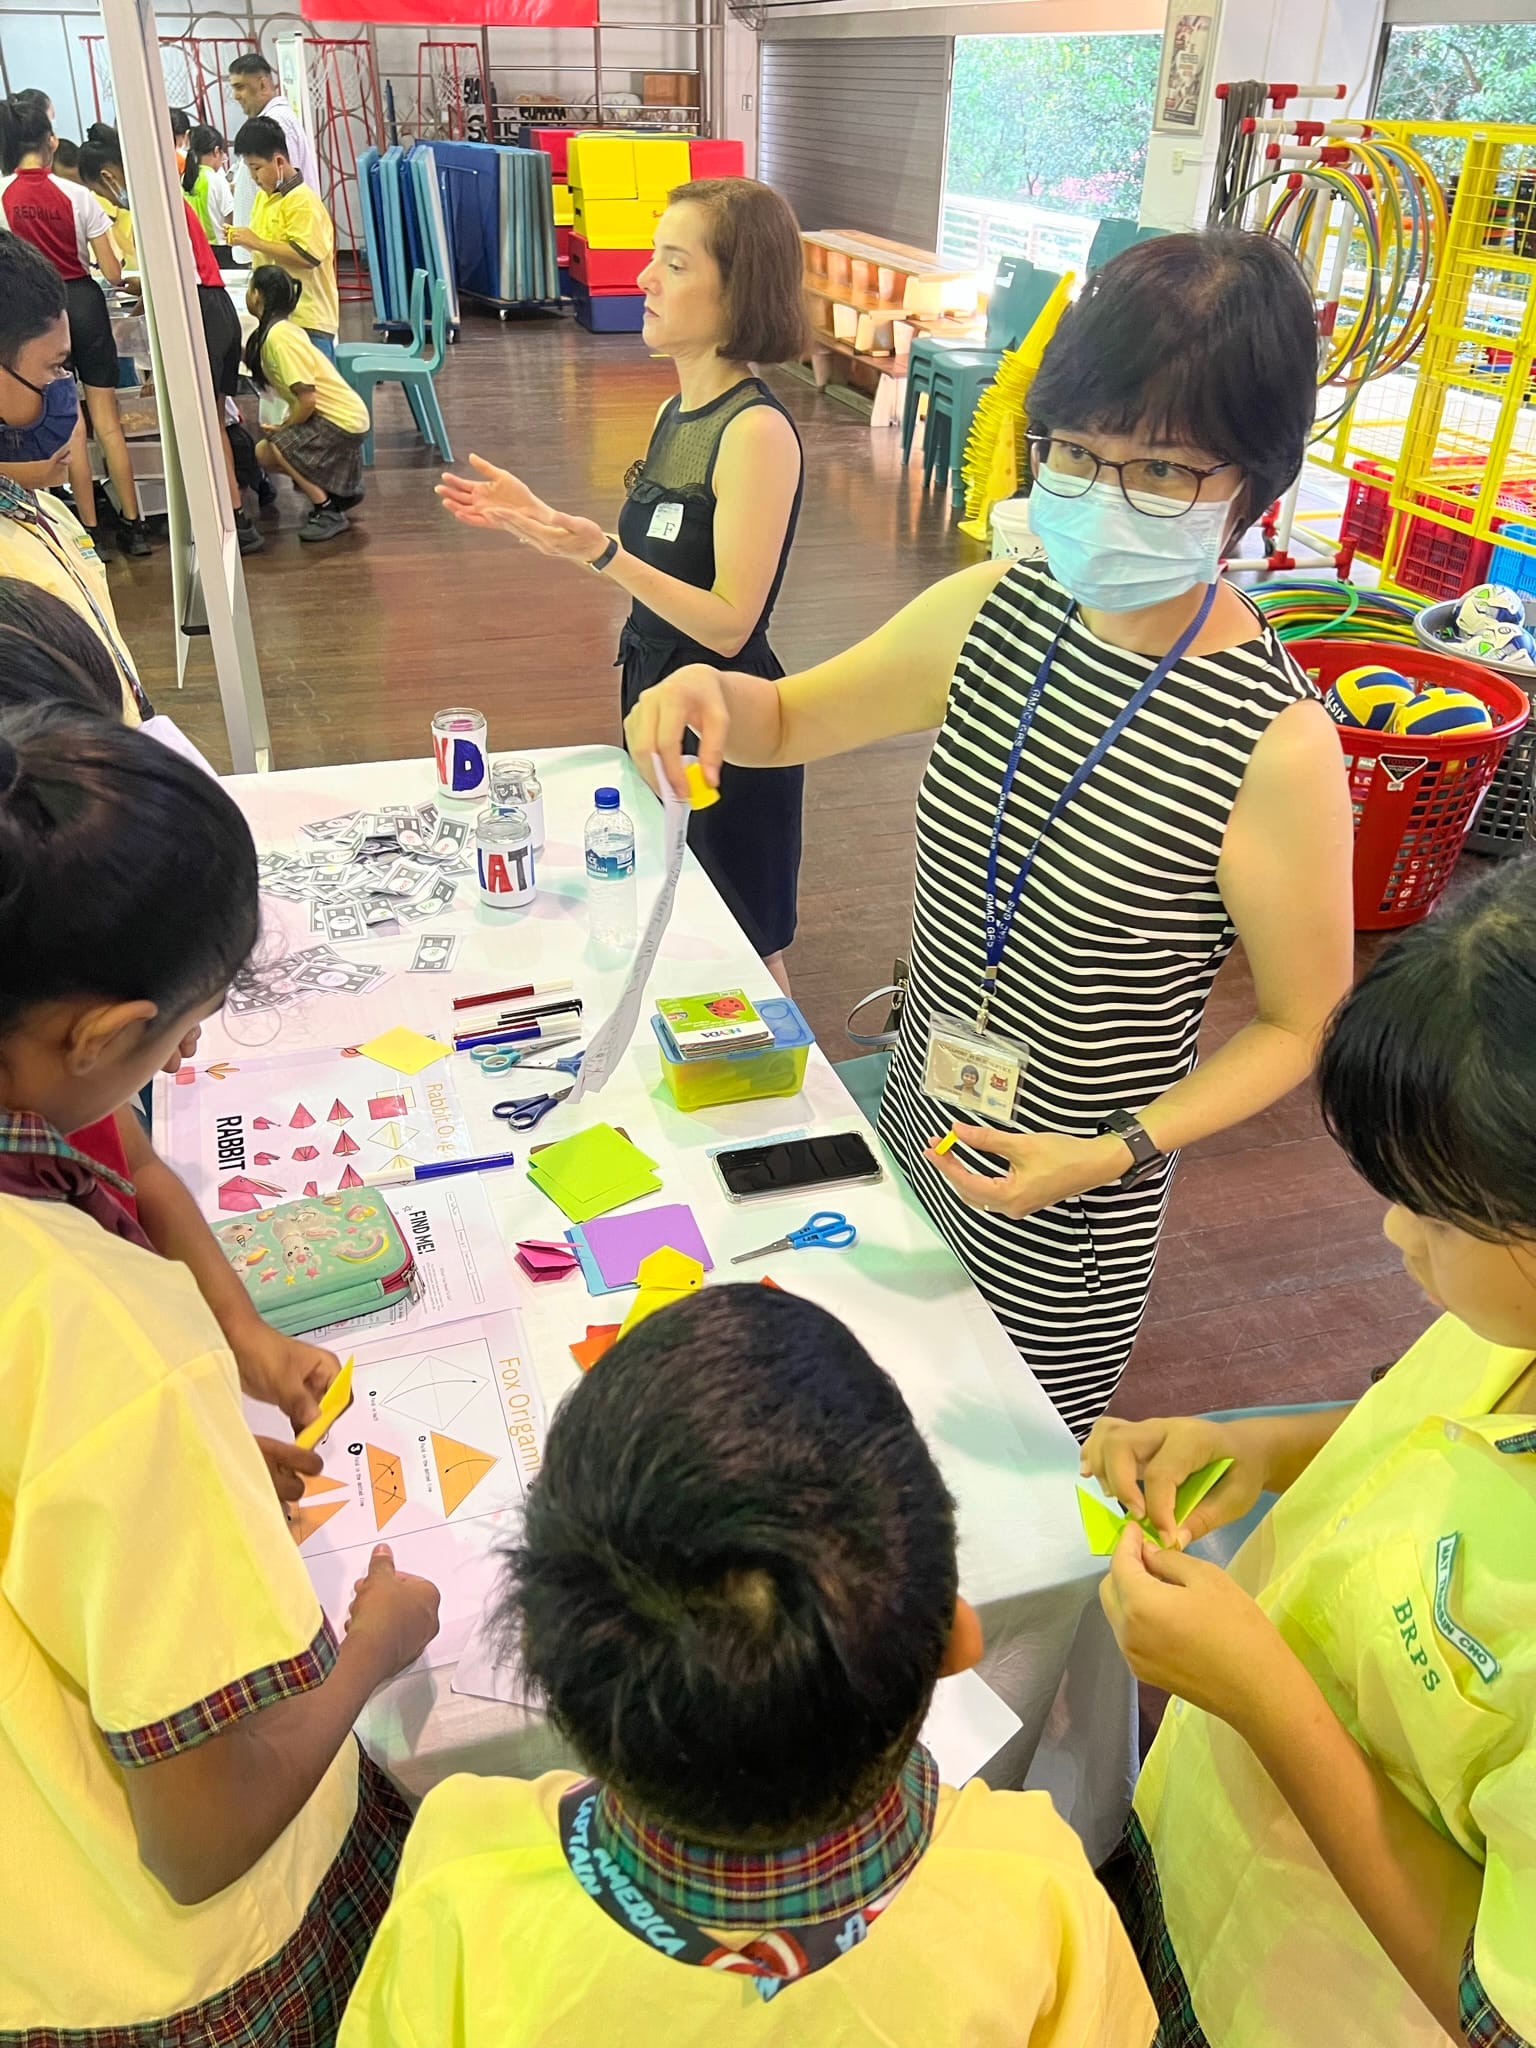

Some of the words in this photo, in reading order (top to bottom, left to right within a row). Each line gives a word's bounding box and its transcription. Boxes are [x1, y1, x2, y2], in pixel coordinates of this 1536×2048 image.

[663, 522, 676, 536] F
[426, 1083, 449, 1123] Rabbit
[216, 1115, 246, 1171] RABBIT
[409, 1210, 431, 1234] FIND
[415, 1234, 436, 1255] ME!
[499, 1356, 521, 1390] Fox
[508, 1393, 541, 1472] Origami
[1392, 1597, 1441, 1692] BRPS
[1458, 1636, 1488, 1665] CHO
[568, 1795, 603, 1896] CAPTAIN
[593, 1847, 688, 1956] AMERICA
